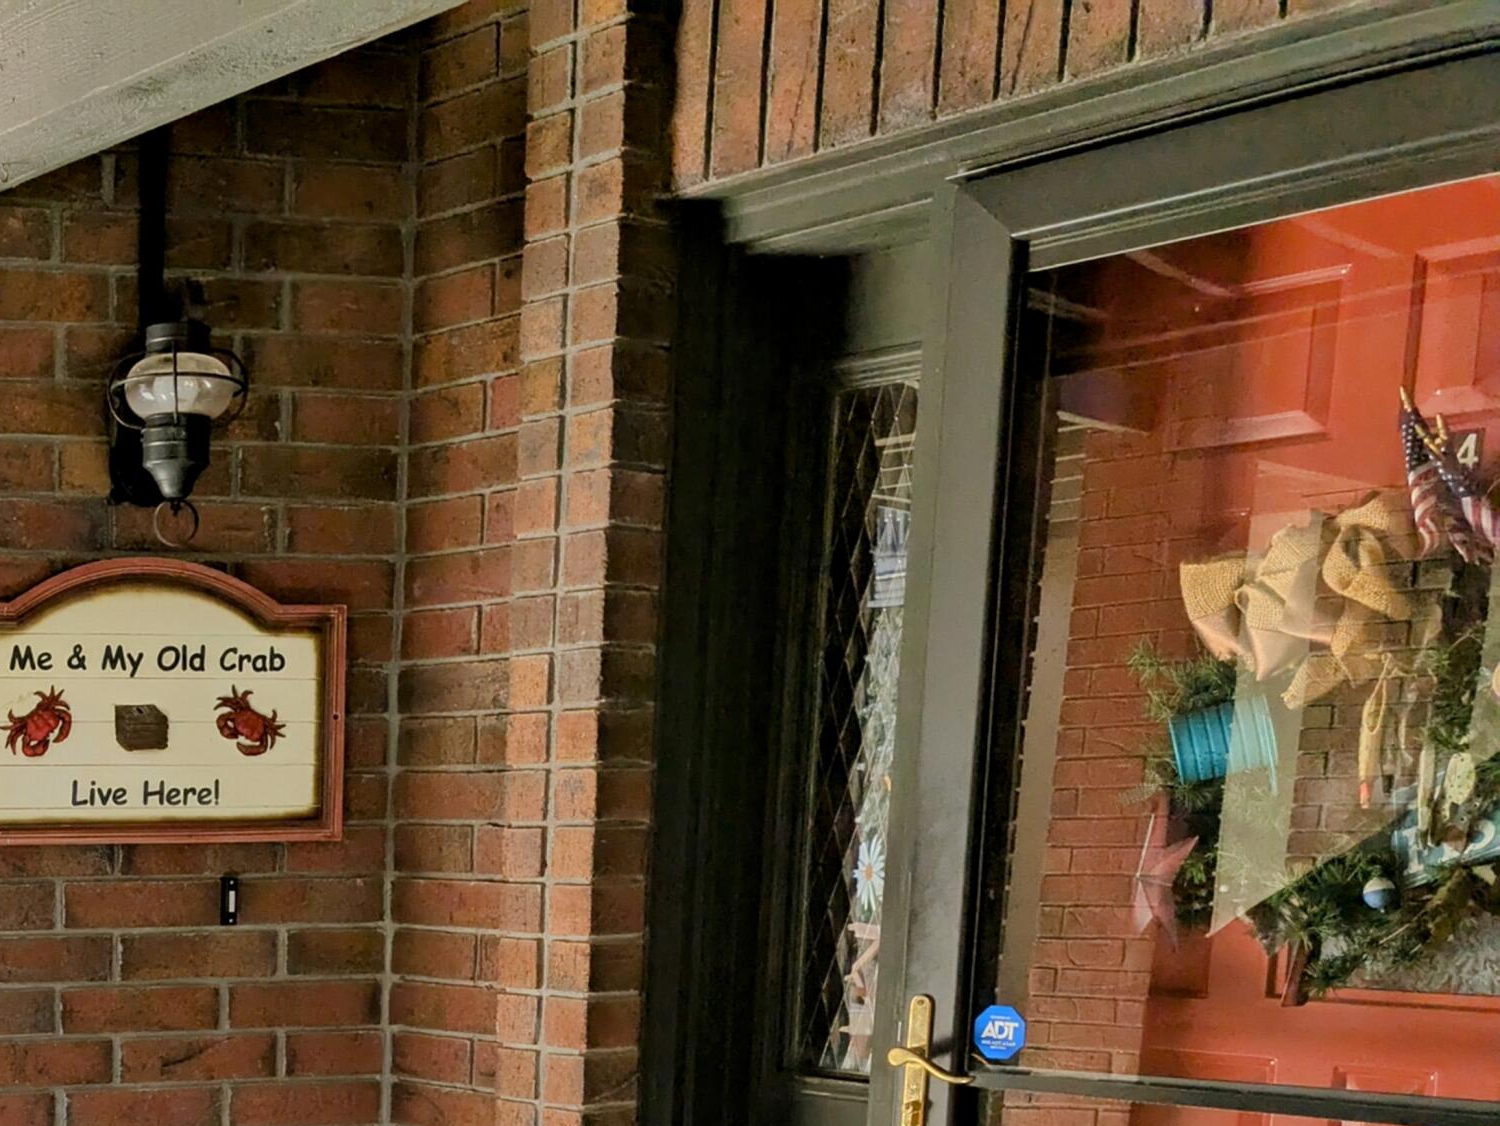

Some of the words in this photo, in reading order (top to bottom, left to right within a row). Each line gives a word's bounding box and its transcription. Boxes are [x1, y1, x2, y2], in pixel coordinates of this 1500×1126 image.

[1456, 432, 1479, 470] 4
[9, 644, 53, 671] Me
[66, 643, 87, 671] &
[101, 644, 144, 678] My
[156, 645, 206, 672] Old
[219, 646, 286, 673] Crab
[71, 779, 128, 807] Live
[142, 779, 220, 806] Here!
[980, 1020, 1019, 1041] ADT
